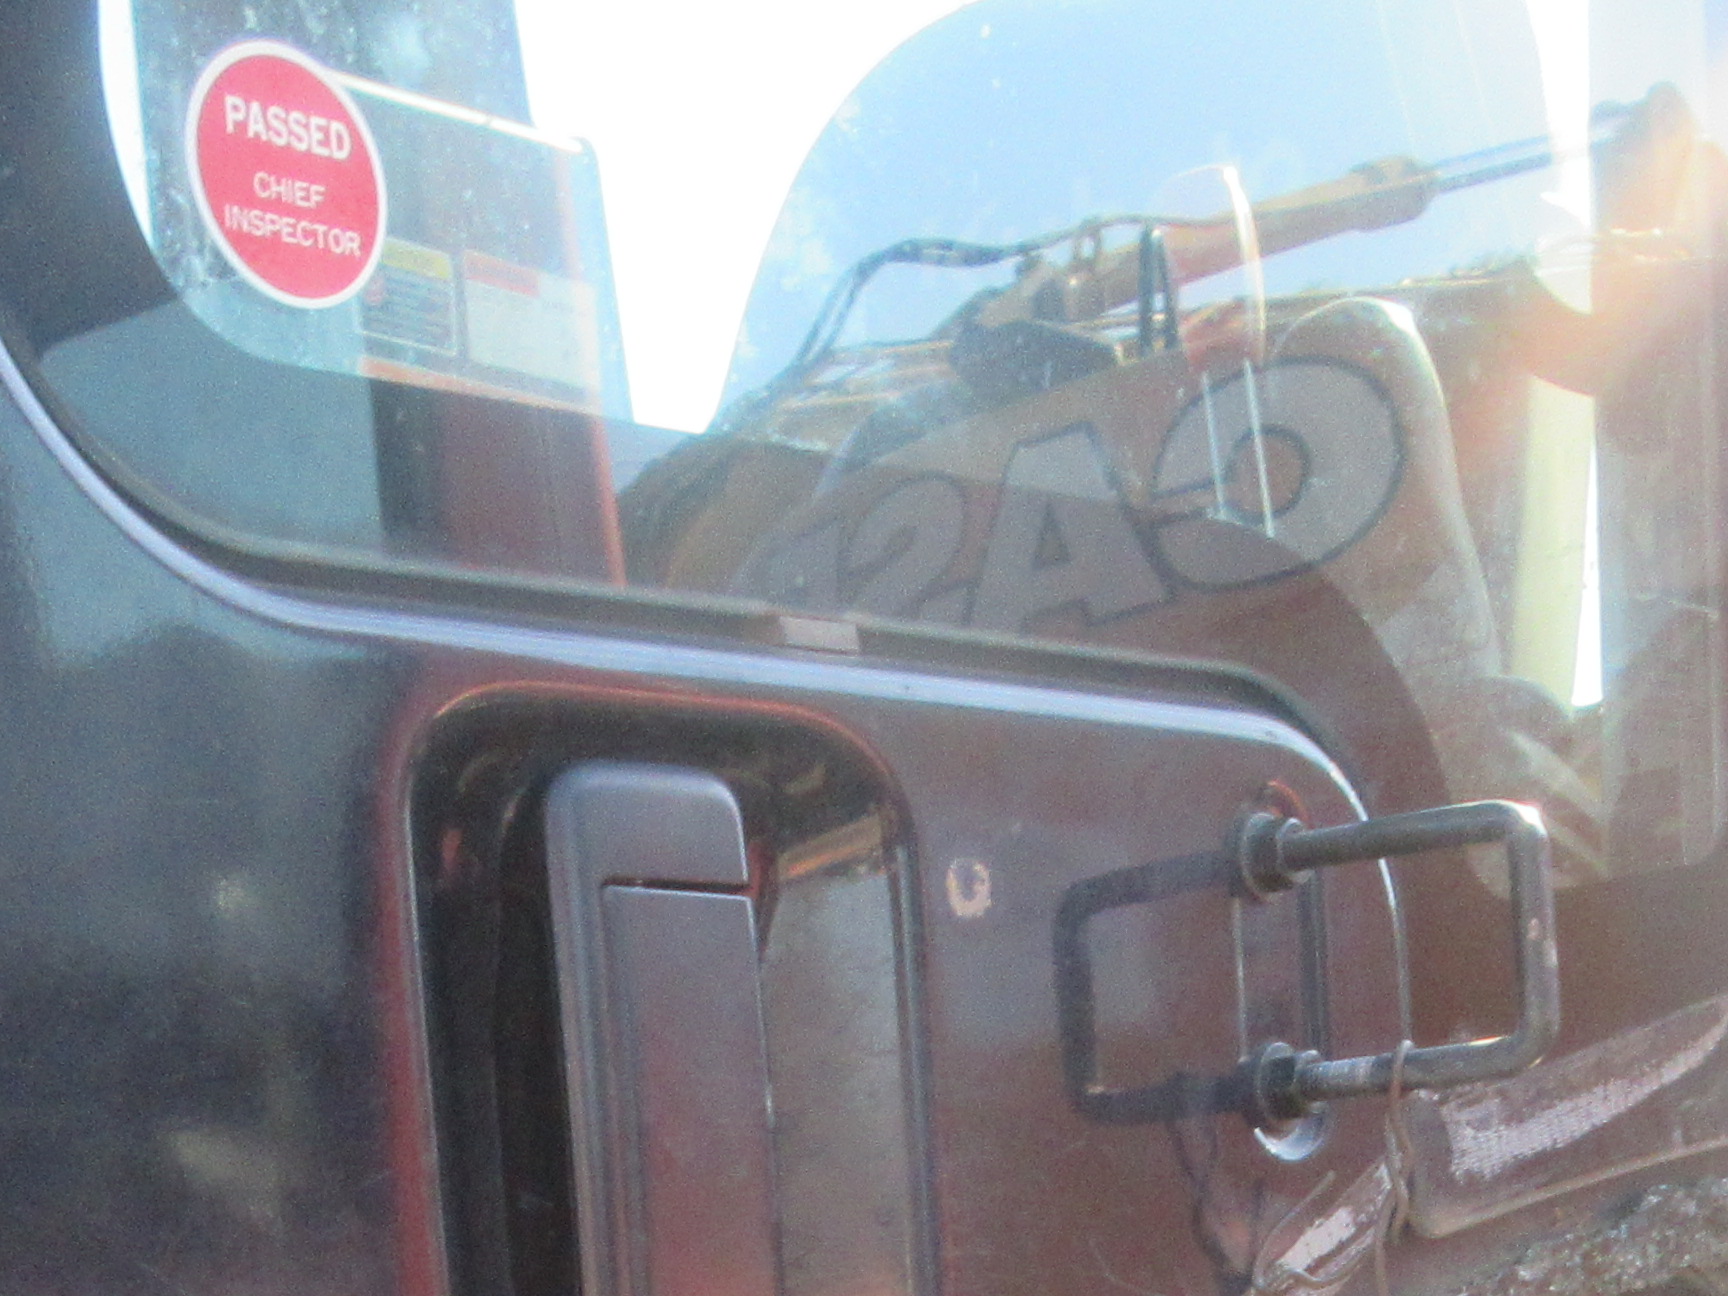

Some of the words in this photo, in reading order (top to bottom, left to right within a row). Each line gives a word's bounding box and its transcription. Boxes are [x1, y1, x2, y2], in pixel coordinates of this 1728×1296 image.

[225, 94, 351, 160] PASSED
[253, 171, 325, 208] CHIEF
[225, 204, 361, 257] INSPECTOR
